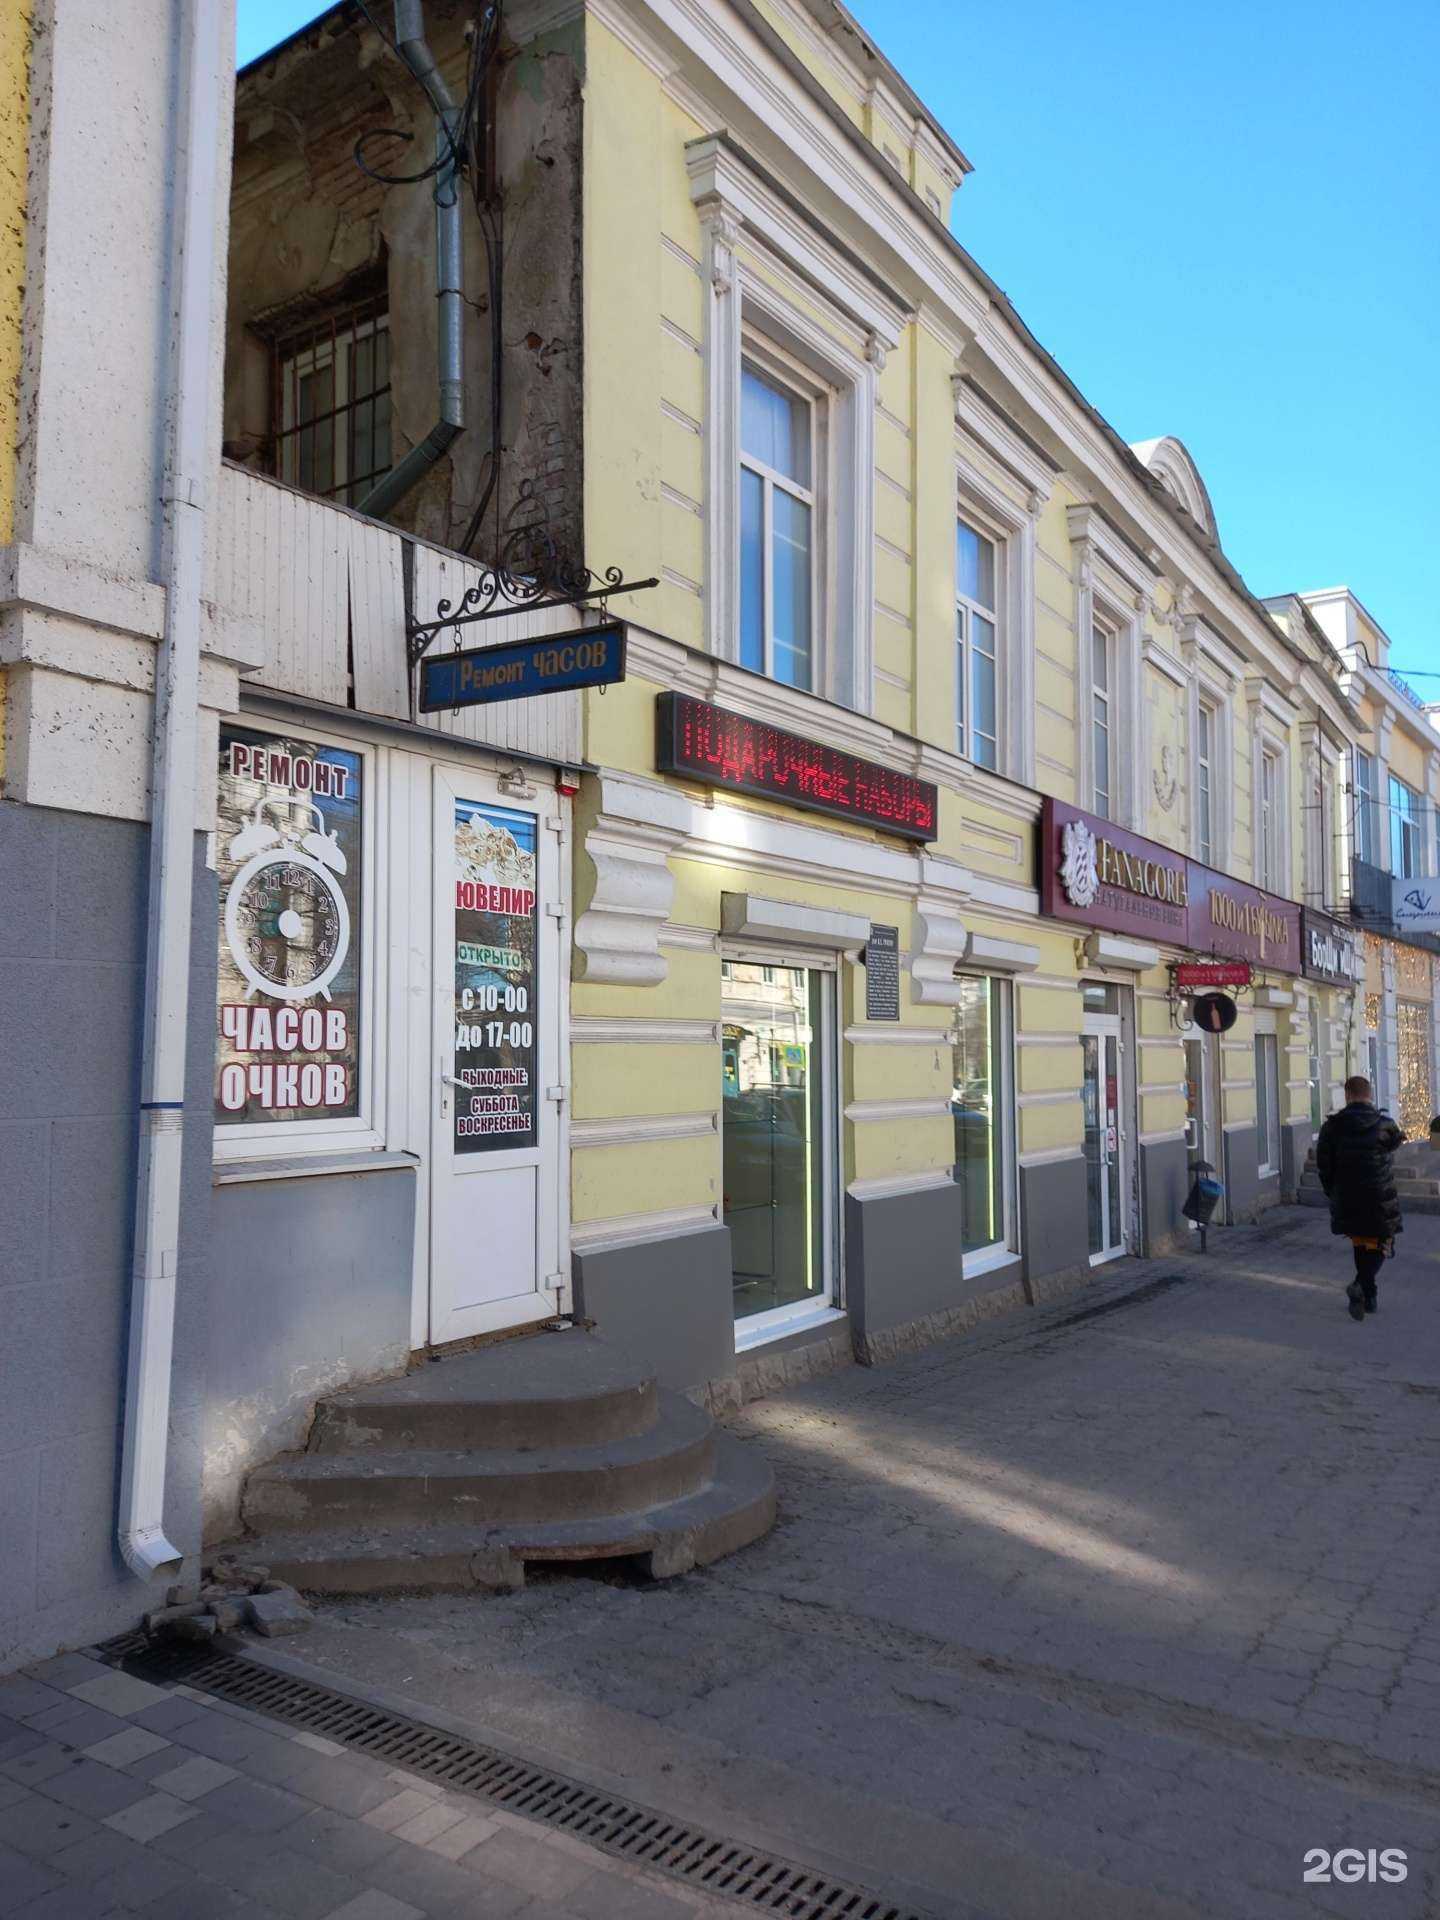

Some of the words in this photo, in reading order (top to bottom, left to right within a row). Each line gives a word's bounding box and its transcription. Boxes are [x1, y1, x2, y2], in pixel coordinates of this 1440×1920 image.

[230, 742, 348, 799] РЕМОНТ
[264, 873, 281, 891] 11
[282, 868, 301, 887] 12
[1100, 838, 1188, 907] FANAGORIA
[317, 895, 329, 914] 2
[455, 880, 535, 917] ЮВЕЛИР
[324, 918, 334, 936] 3
[459, 945, 522, 967] ОТКРЫТО
[477, 984, 528, 1013] 10-00
[222, 1005, 348, 1051] ЧАСОВ
[485, 1021, 533, 1048] 17-00
[220, 1063, 348, 1111] ОЧКОВ
[471, 1094, 519, 1115] СУББОТА
[457, 1113, 532, 1136] ВОСКРЕСЕНЬЕ
